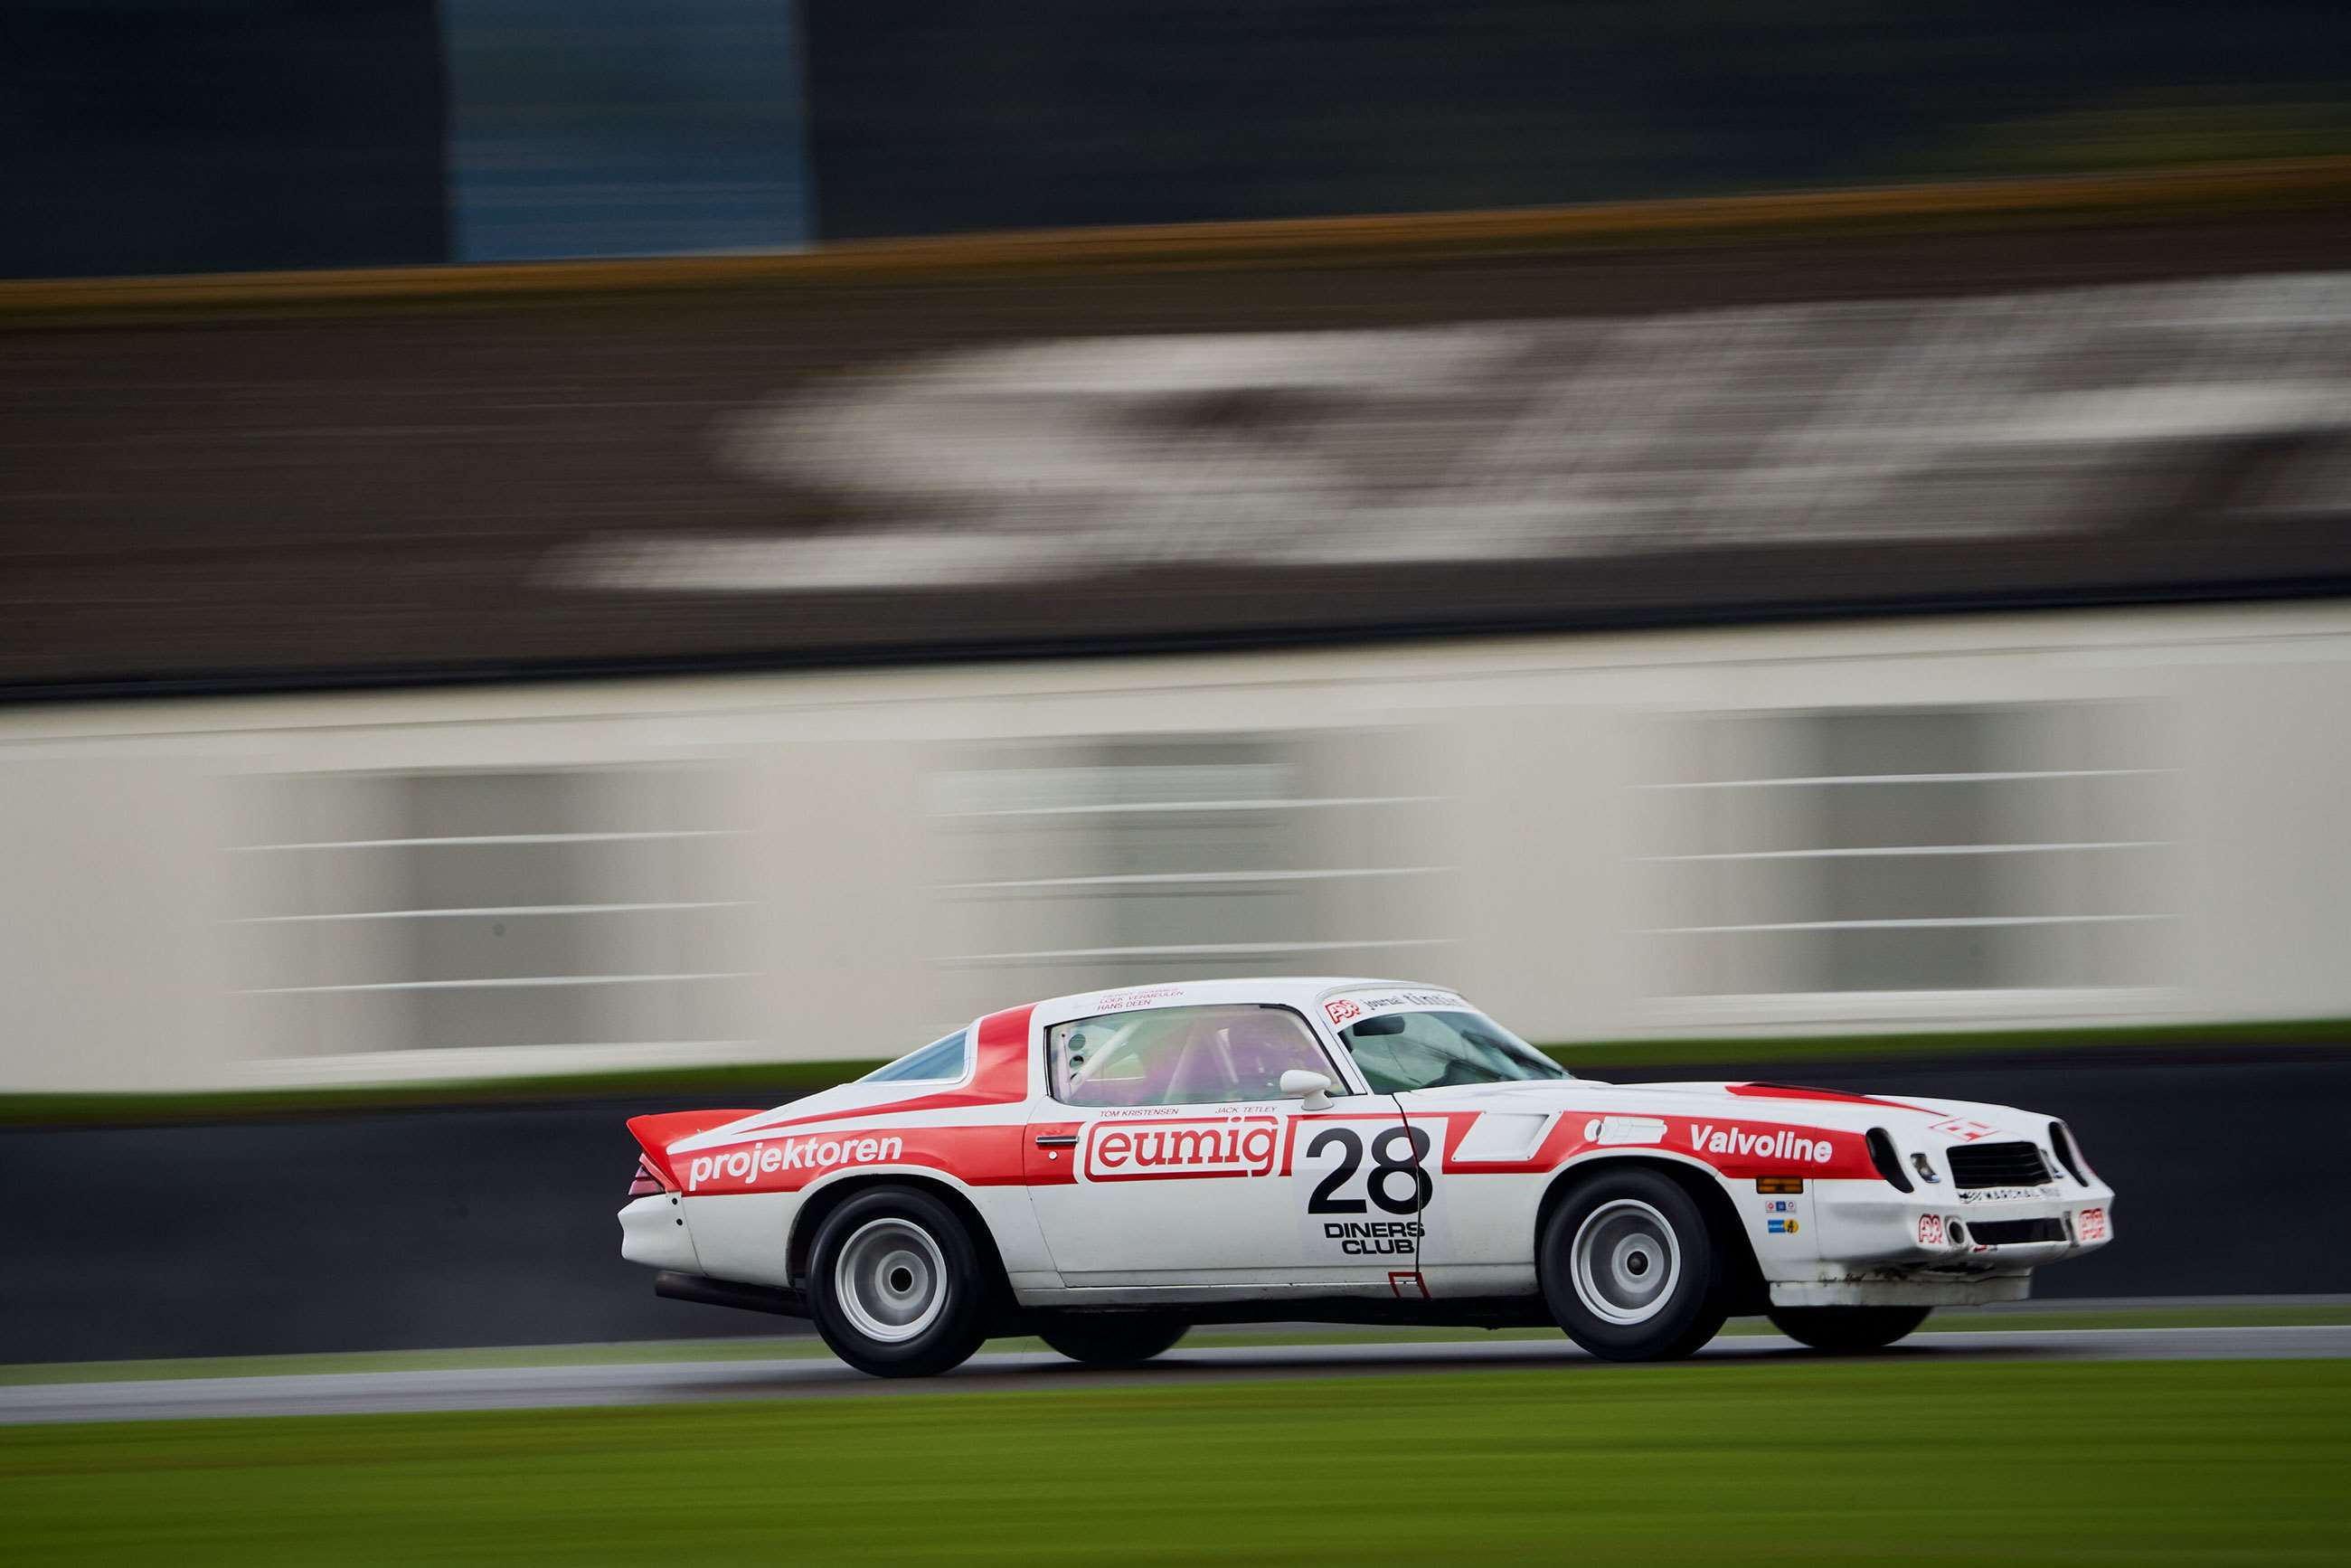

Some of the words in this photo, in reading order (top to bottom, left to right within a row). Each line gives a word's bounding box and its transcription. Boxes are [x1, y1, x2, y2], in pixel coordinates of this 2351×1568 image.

[1097, 1003, 1123, 1011] HANS
[1126, 999, 1151, 1007] DEEN
[1100, 1110, 1119, 1118] TOM
[1121, 1108, 1179, 1117] KRISTENSEN
[1099, 1117, 1279, 1177] eumig
[1690, 1124, 1833, 1164] Valvoline
[689, 1136, 903, 1192] projektoren
[1306, 1126, 1433, 1215] 28
[1324, 1222, 1426, 1239] DINERS
[1342, 1239, 1415, 1255] CLUB
